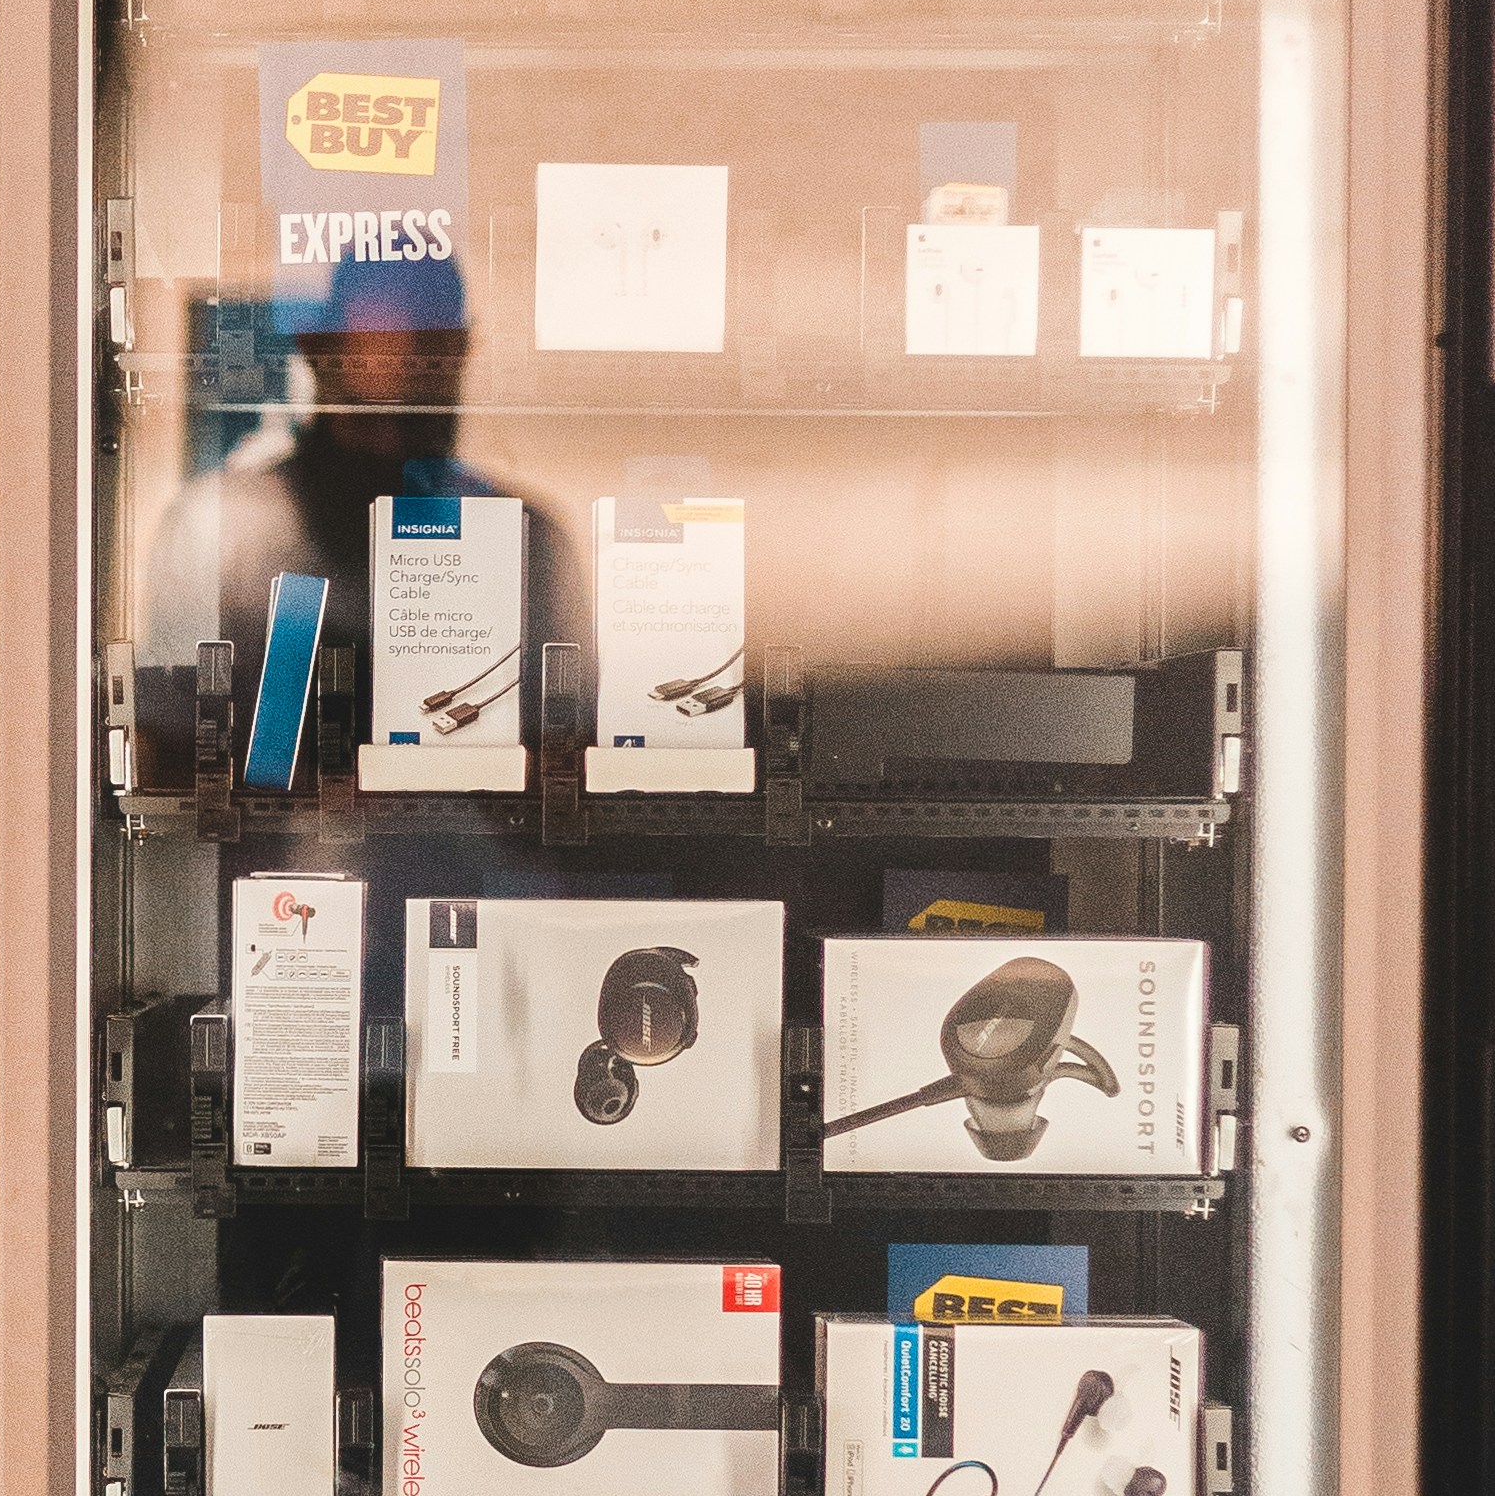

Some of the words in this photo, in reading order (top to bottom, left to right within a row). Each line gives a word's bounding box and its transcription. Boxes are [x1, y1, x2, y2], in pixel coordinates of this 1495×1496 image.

[305, 91, 436, 126] BEST
[309, 124, 422, 159] BUY
[279, 209, 453, 264] EXPRESS
[397, 525, 453, 534] INSIGNIA
[620, 529, 677, 538] INSIGNIA
[390, 553, 429, 567] Micro
[433, 553, 462, 567] USB
[613, 557, 712, 576] Charge/Sync
[389, 570, 479, 587] Charge/Sync
[613, 575, 658, 590] Cable
[389, 585, 431, 600] Cable
[389, 607, 430, 622] Câble
[433, 607, 473, 622] micro
[612, 600, 655, 614] Câble
[658, 600, 679, 614] de
[682, 601, 730, 618] charge
[389, 625, 416, 641] USB
[420, 625, 438, 641] de
[442, 625, 492, 641] charge/
[613, 620, 626, 632] et
[629, 620, 737, 635] synchronisation
[389, 642, 492, 657] synchronisation
[451, 965, 461, 1035] SOUNDSPORT
[451, 1038, 461, 1061] FREE
[1139, 960, 1157, 1156] SOUNDSPORT
[744, 1273, 762, 1288] 40
[744, 1289, 762, 1306] HR
[938, 1341, 949, 1387] ACOUSTIC
[901, 1341, 912, 1413] QuietComfort
[938, 1389, 949, 1418] NOISE
[901, 1417, 912, 1431] 20
